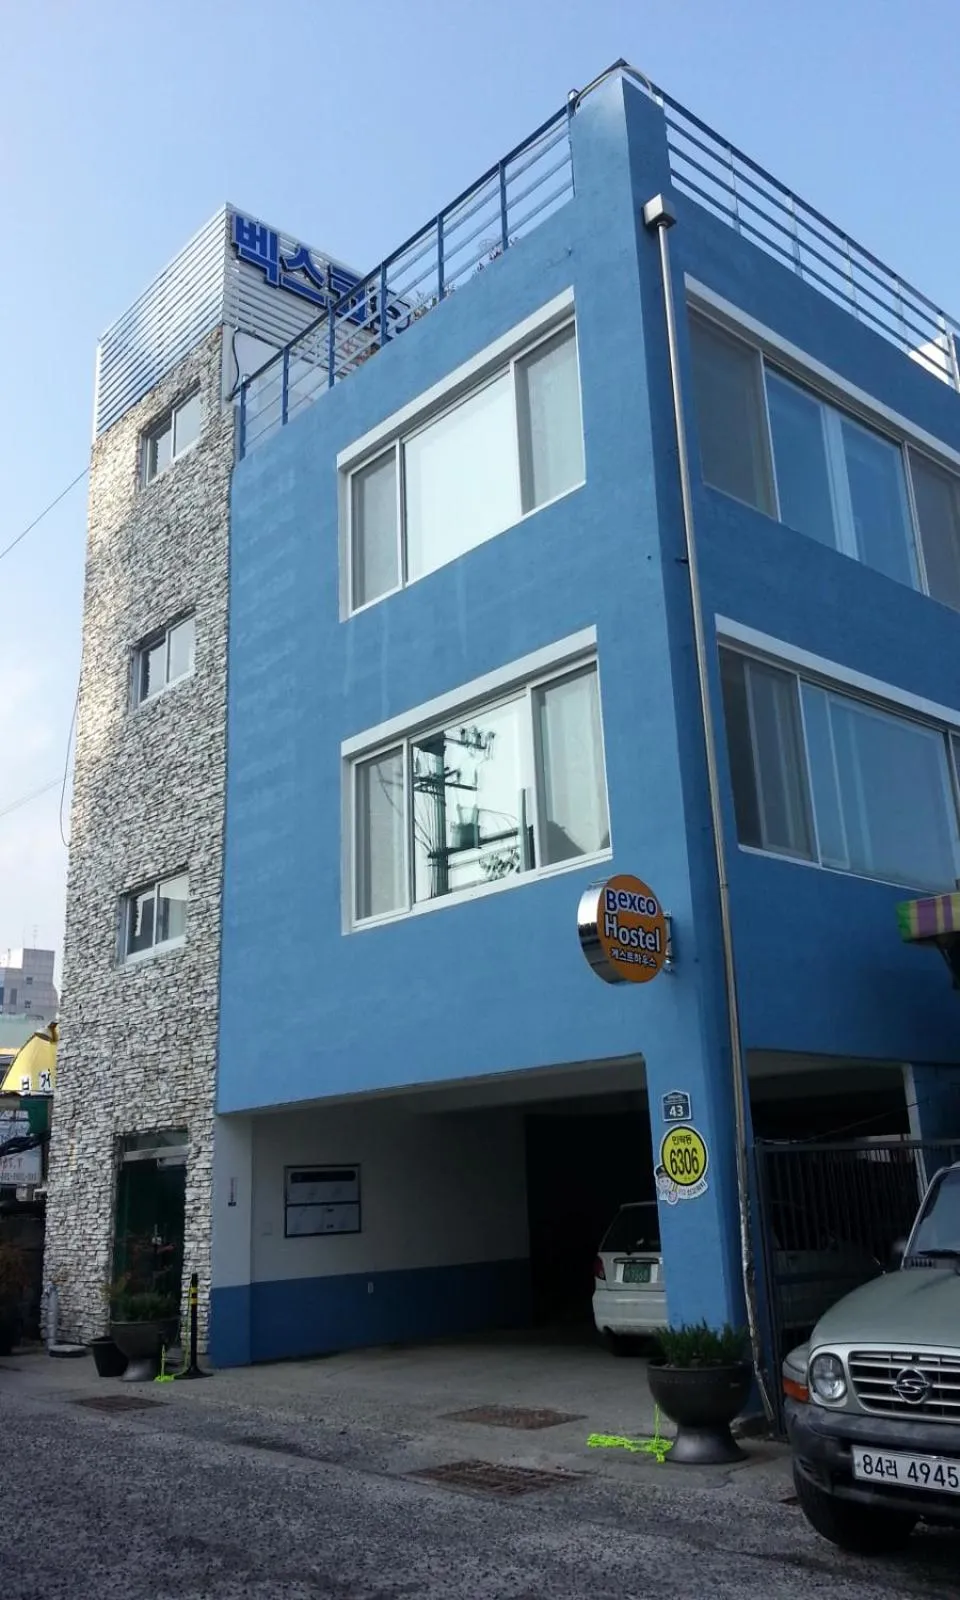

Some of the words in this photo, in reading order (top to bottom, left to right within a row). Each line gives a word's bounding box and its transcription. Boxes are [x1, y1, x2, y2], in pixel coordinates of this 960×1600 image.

[605, 888, 657, 916] Bexco
[604, 913, 660, 952] Hostel
[669, 1104, 684, 1117] 43
[669, 1147, 700, 1175] 6306
[906, 1461, 960, 1488] 4945
